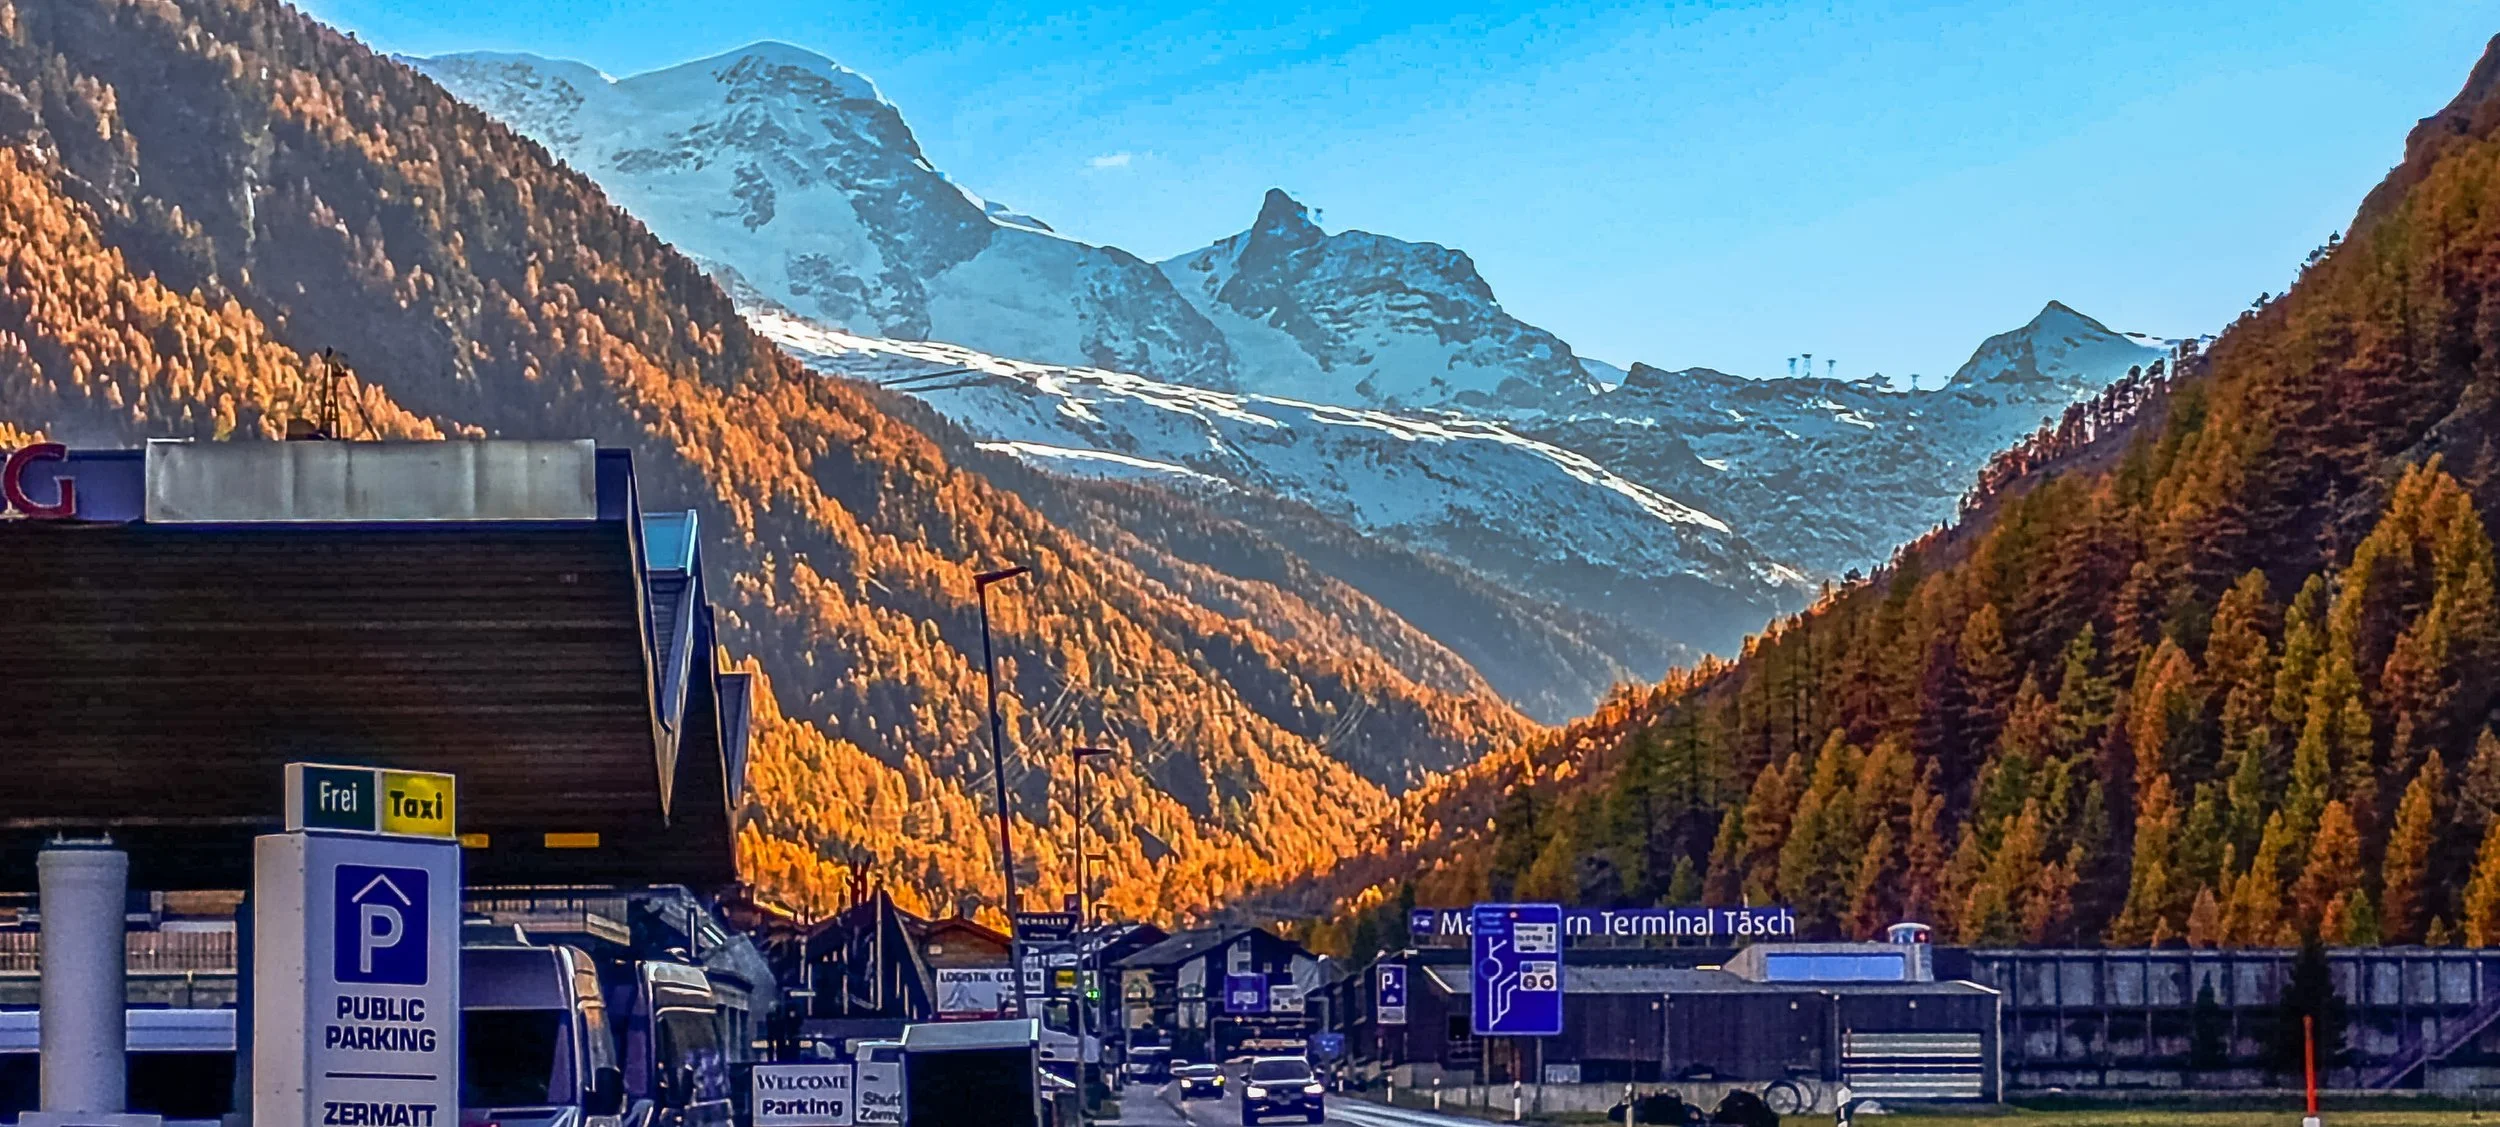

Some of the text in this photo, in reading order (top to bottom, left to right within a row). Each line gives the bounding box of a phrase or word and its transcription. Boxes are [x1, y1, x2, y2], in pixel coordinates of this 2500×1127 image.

[319, 780, 358, 813] Frei
[390, 789, 444, 820] Taxi
[1601, 908, 1714, 936] Terminal
[1723, 908, 1795, 936] Täsch
[360, 903, 404, 973] P
[940, 971, 992, 983] LOGISTIK
[337, 995, 425, 1022] PUBLIC
[325, 1025, 436, 1052] PARKING
[756, 1074, 849, 1090] WELCOME
[324, 1101, 437, 1127] ZERMATT
[762, 1098, 843, 1118] Parking
